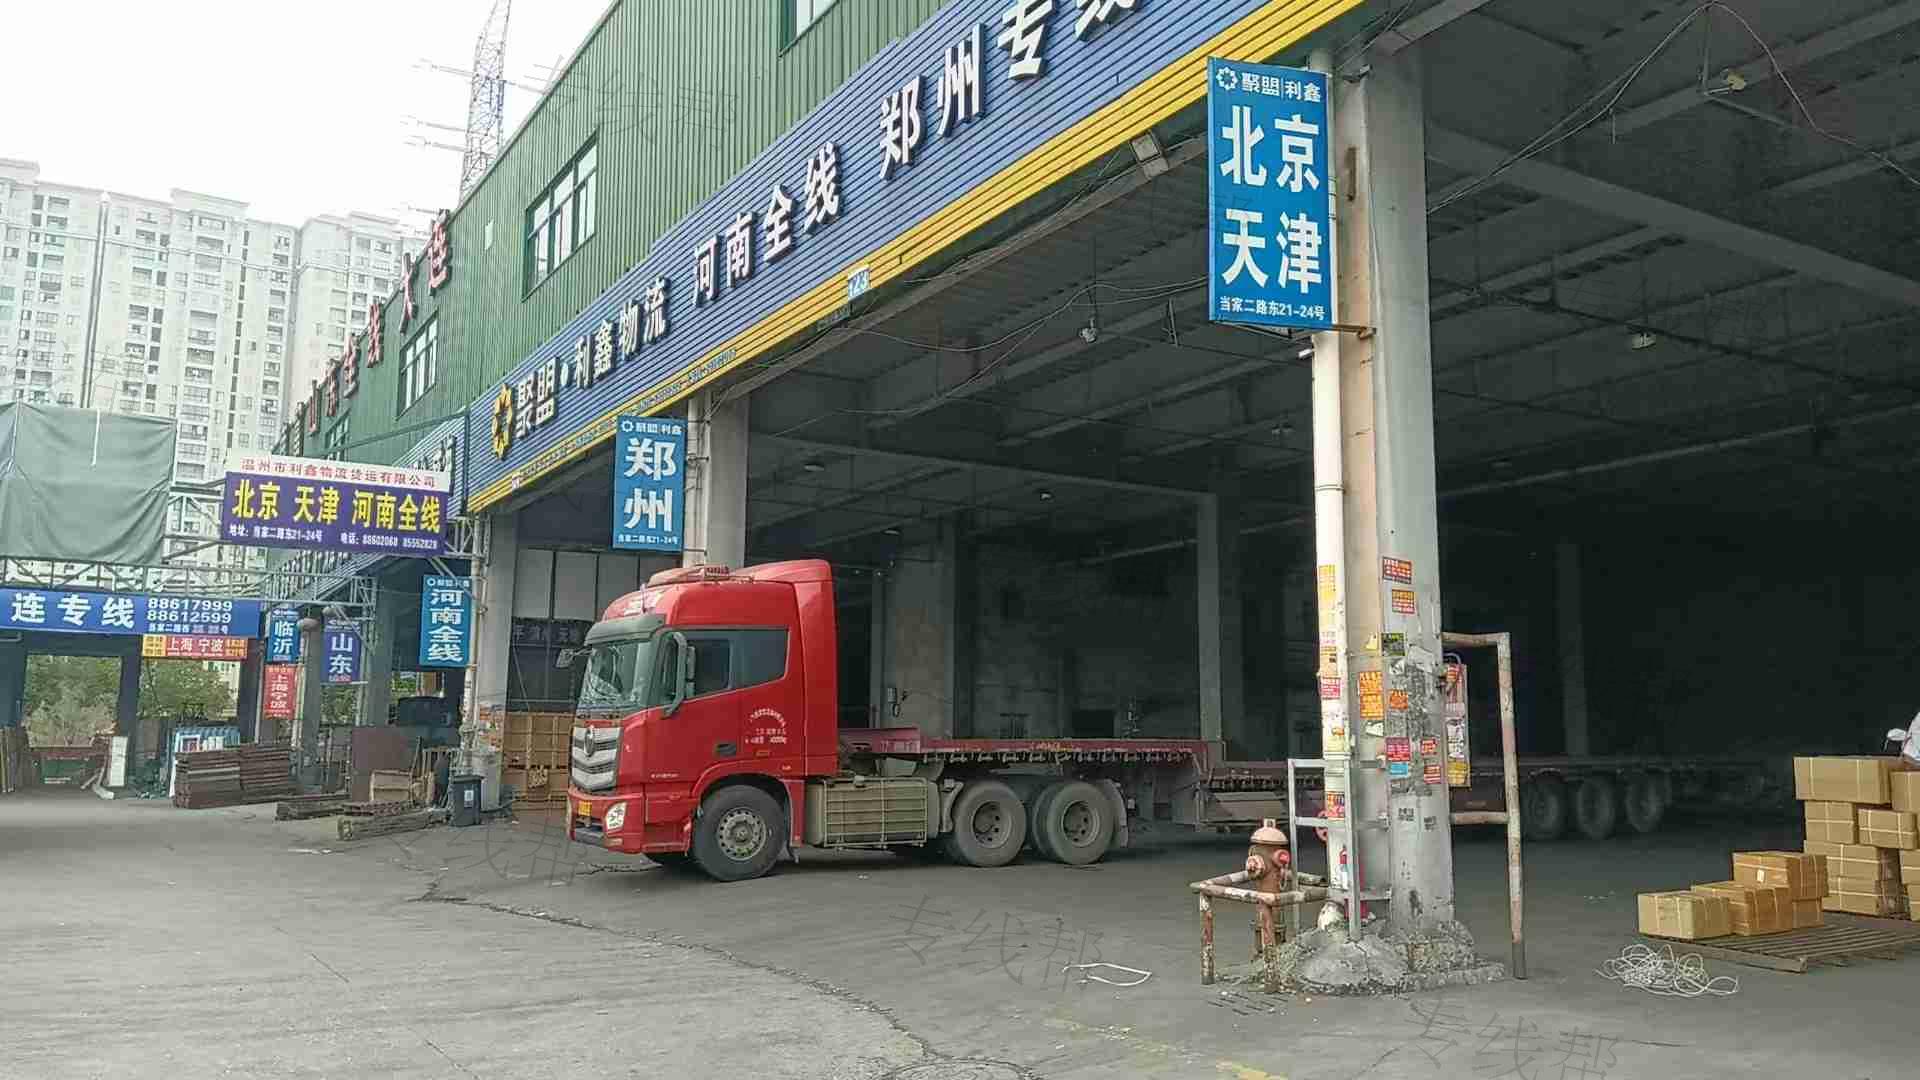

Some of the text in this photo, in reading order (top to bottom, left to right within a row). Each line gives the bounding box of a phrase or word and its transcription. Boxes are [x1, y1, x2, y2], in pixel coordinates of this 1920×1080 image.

[1220, 104, 1321, 193] 北京
[693, 140, 841, 307] 河南全线
[1221, 207, 1322, 294] 天津
[1219, 296, 1326, 321] 当家二路东21-24号
[240, 457, 437, 489] 温州市利鑫物流货运有限公司
[623, 437, 677, 533] 郑州
[231, 479, 441, 533] 北京 天津 河南全线
[11, 593, 135, 629] 连专线
[148, 597, 233, 612] 88617999
[273, 620, 295, 655] 临沂
[427, 588, 465, 662] 河南全线
[167, 637, 193, 652] 上海
[198, 637, 224, 653] 宁波
[328, 632, 354, 675] 山东
[269, 674, 288, 709] 上海宁波
